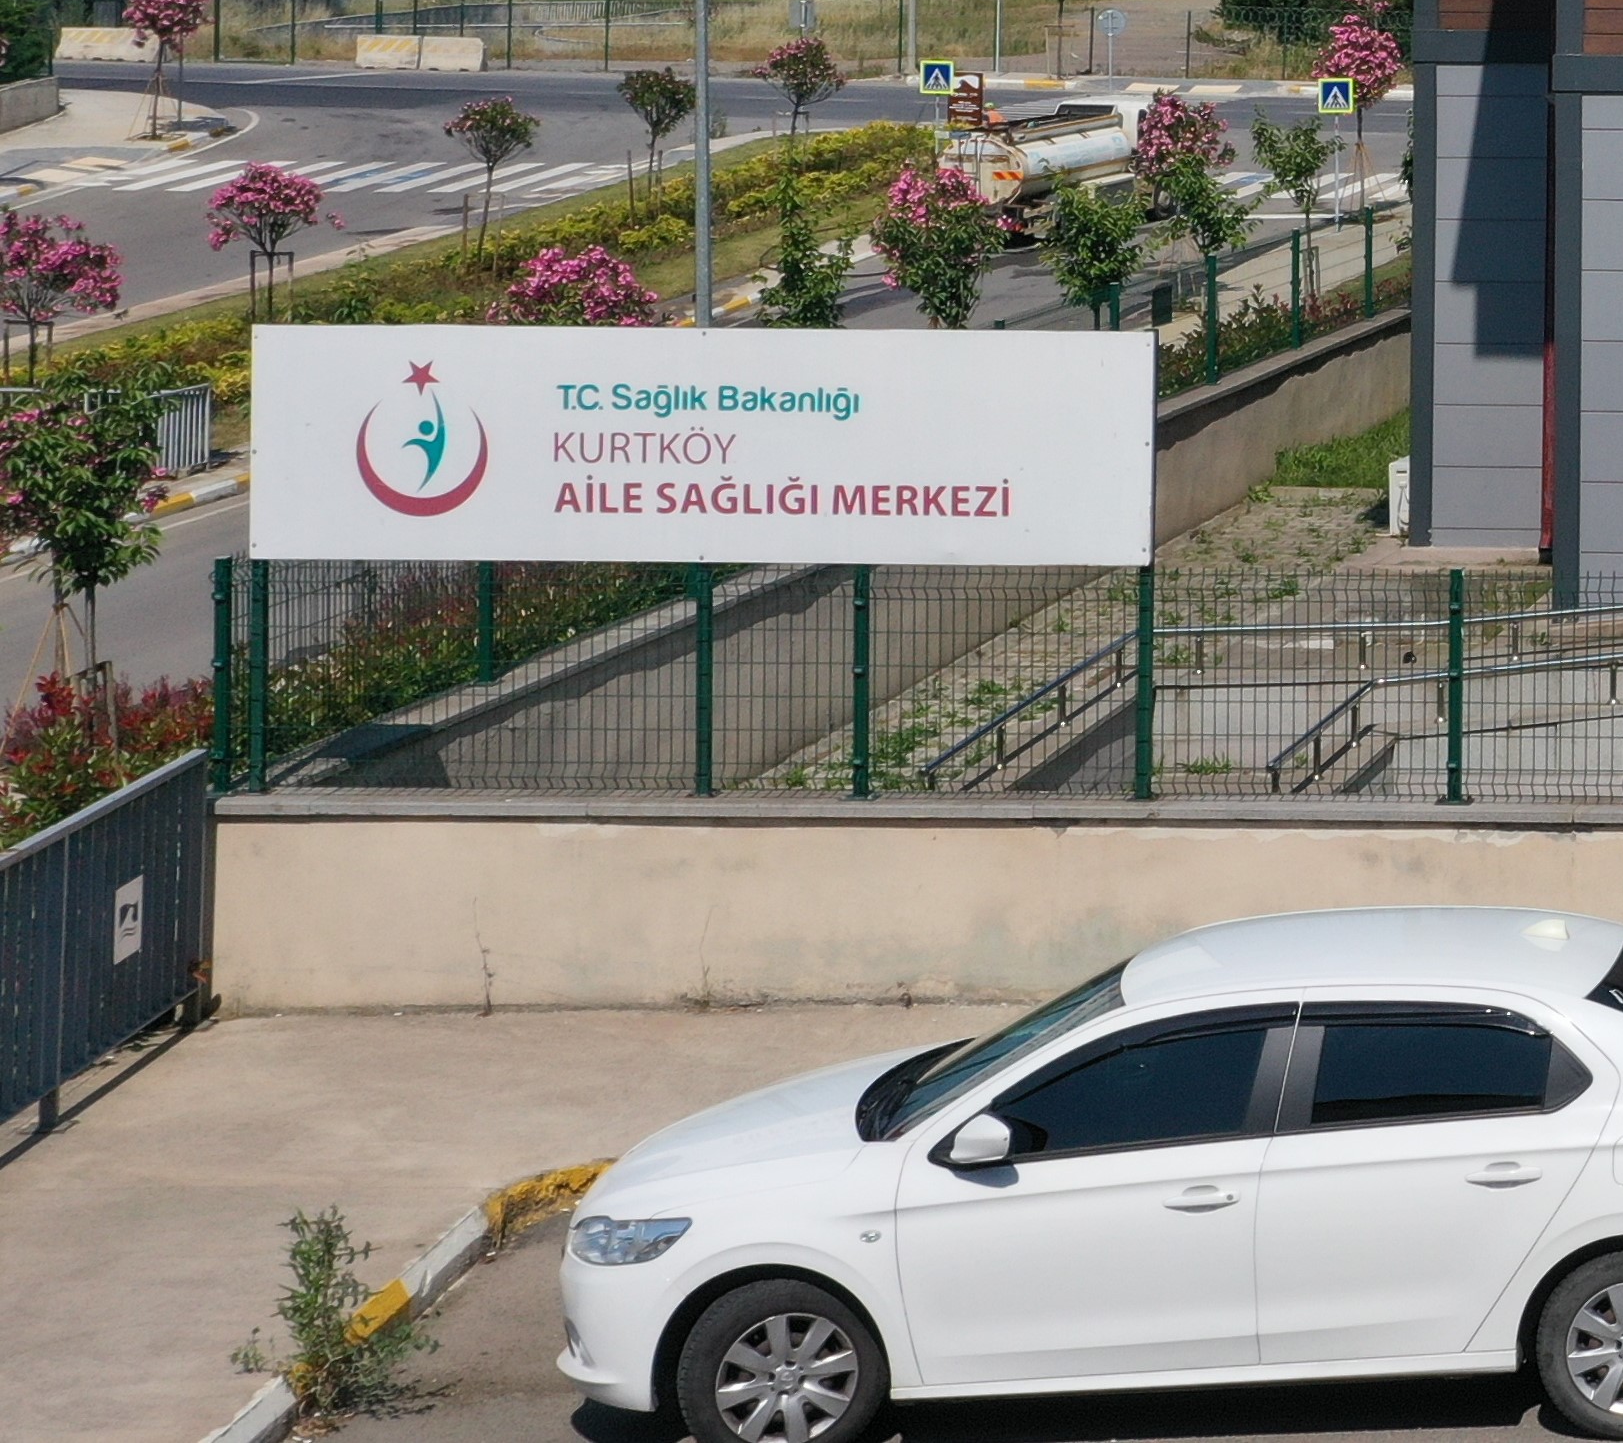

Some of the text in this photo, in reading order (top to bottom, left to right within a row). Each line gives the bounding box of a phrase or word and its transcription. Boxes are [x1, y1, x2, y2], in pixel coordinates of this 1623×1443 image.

[557, 383, 862, 421] T.C. Sağlık Bakanlığı
[552, 426, 738, 465] KURTKÖY
[554, 473, 1012, 517] AİLE SAĞLIĞI MERKEZİ
